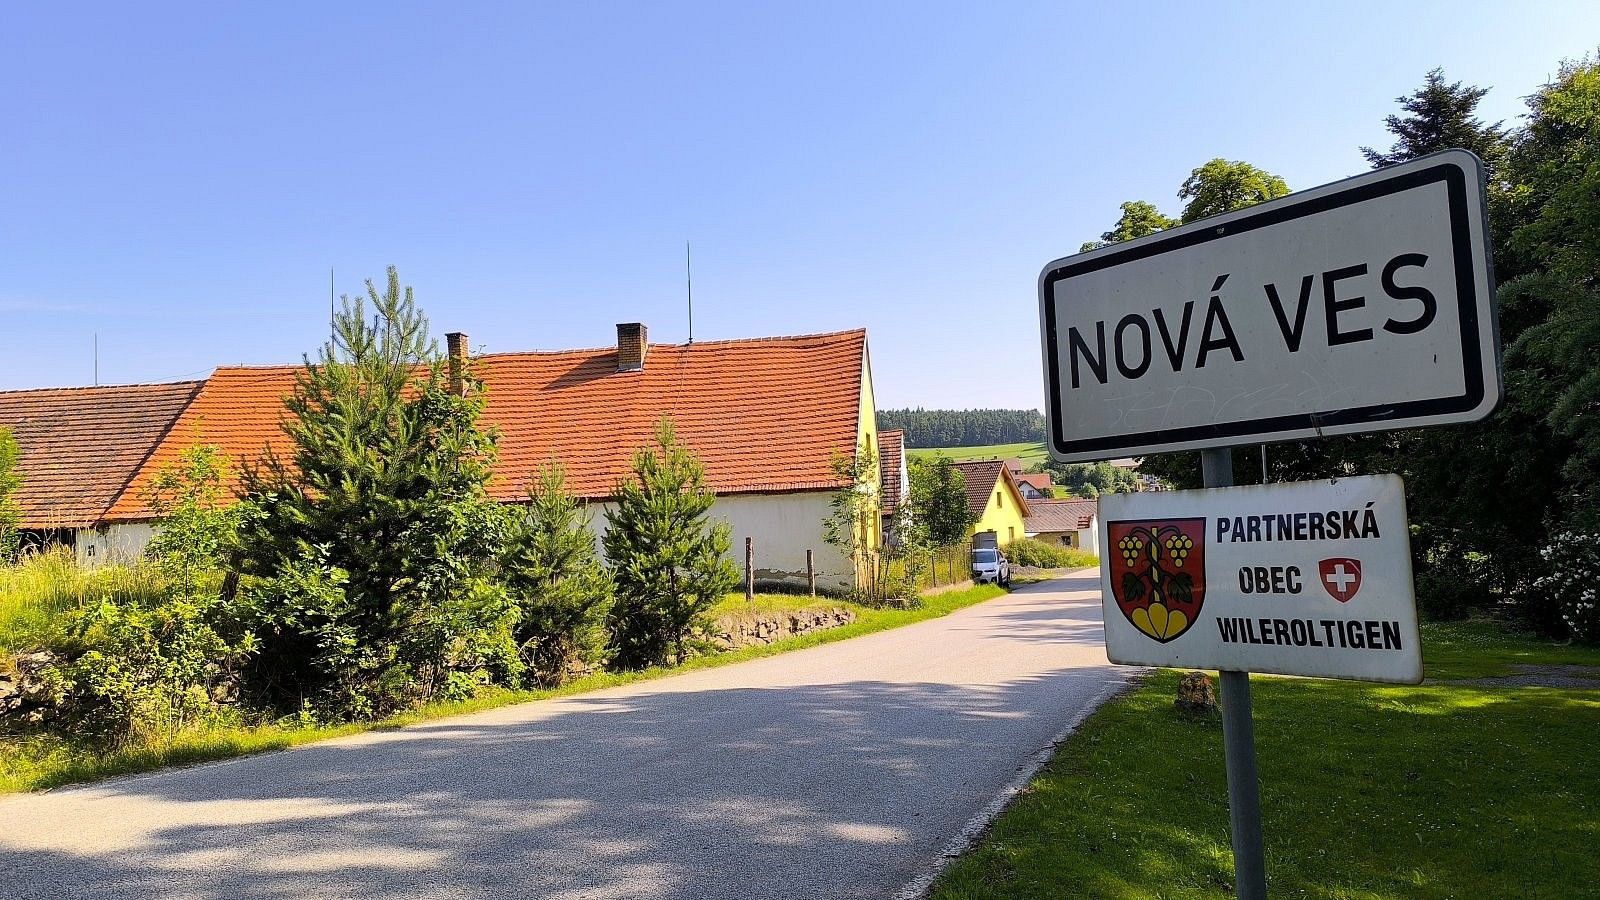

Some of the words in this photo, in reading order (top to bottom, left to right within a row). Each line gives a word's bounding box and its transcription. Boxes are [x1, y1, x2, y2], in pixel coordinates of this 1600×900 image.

[1068, 273, 1245, 389] NOVÁ
[1264, 253, 1437, 353] VES
[1217, 501, 1380, 543] PARTNERSKÁ
[1238, 565, 1302, 594] OBEC
[1216, 617, 1402, 650] WILEROLTIGEN
